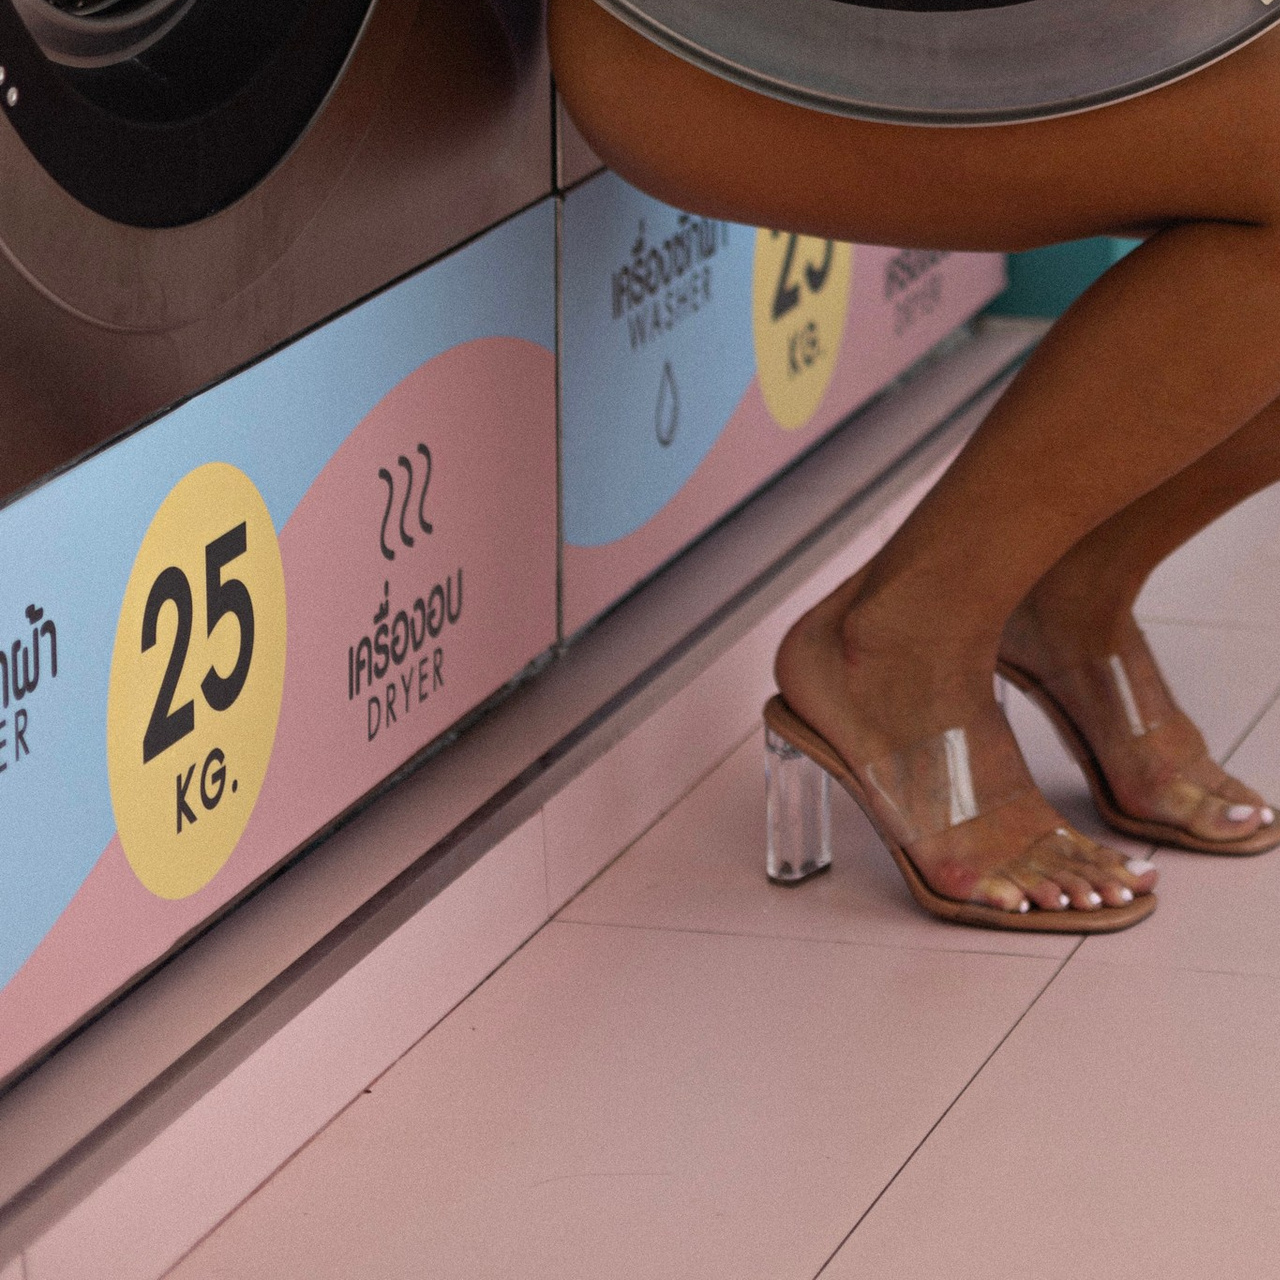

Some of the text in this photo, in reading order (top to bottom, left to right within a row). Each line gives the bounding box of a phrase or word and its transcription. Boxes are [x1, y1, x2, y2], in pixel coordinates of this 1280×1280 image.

[141, 521, 255, 765] 25
[348, 568, 464, 701] เครื่องอบ
[368, 646, 445, 741] DRYER
[176, 748, 238, 835] KG.
